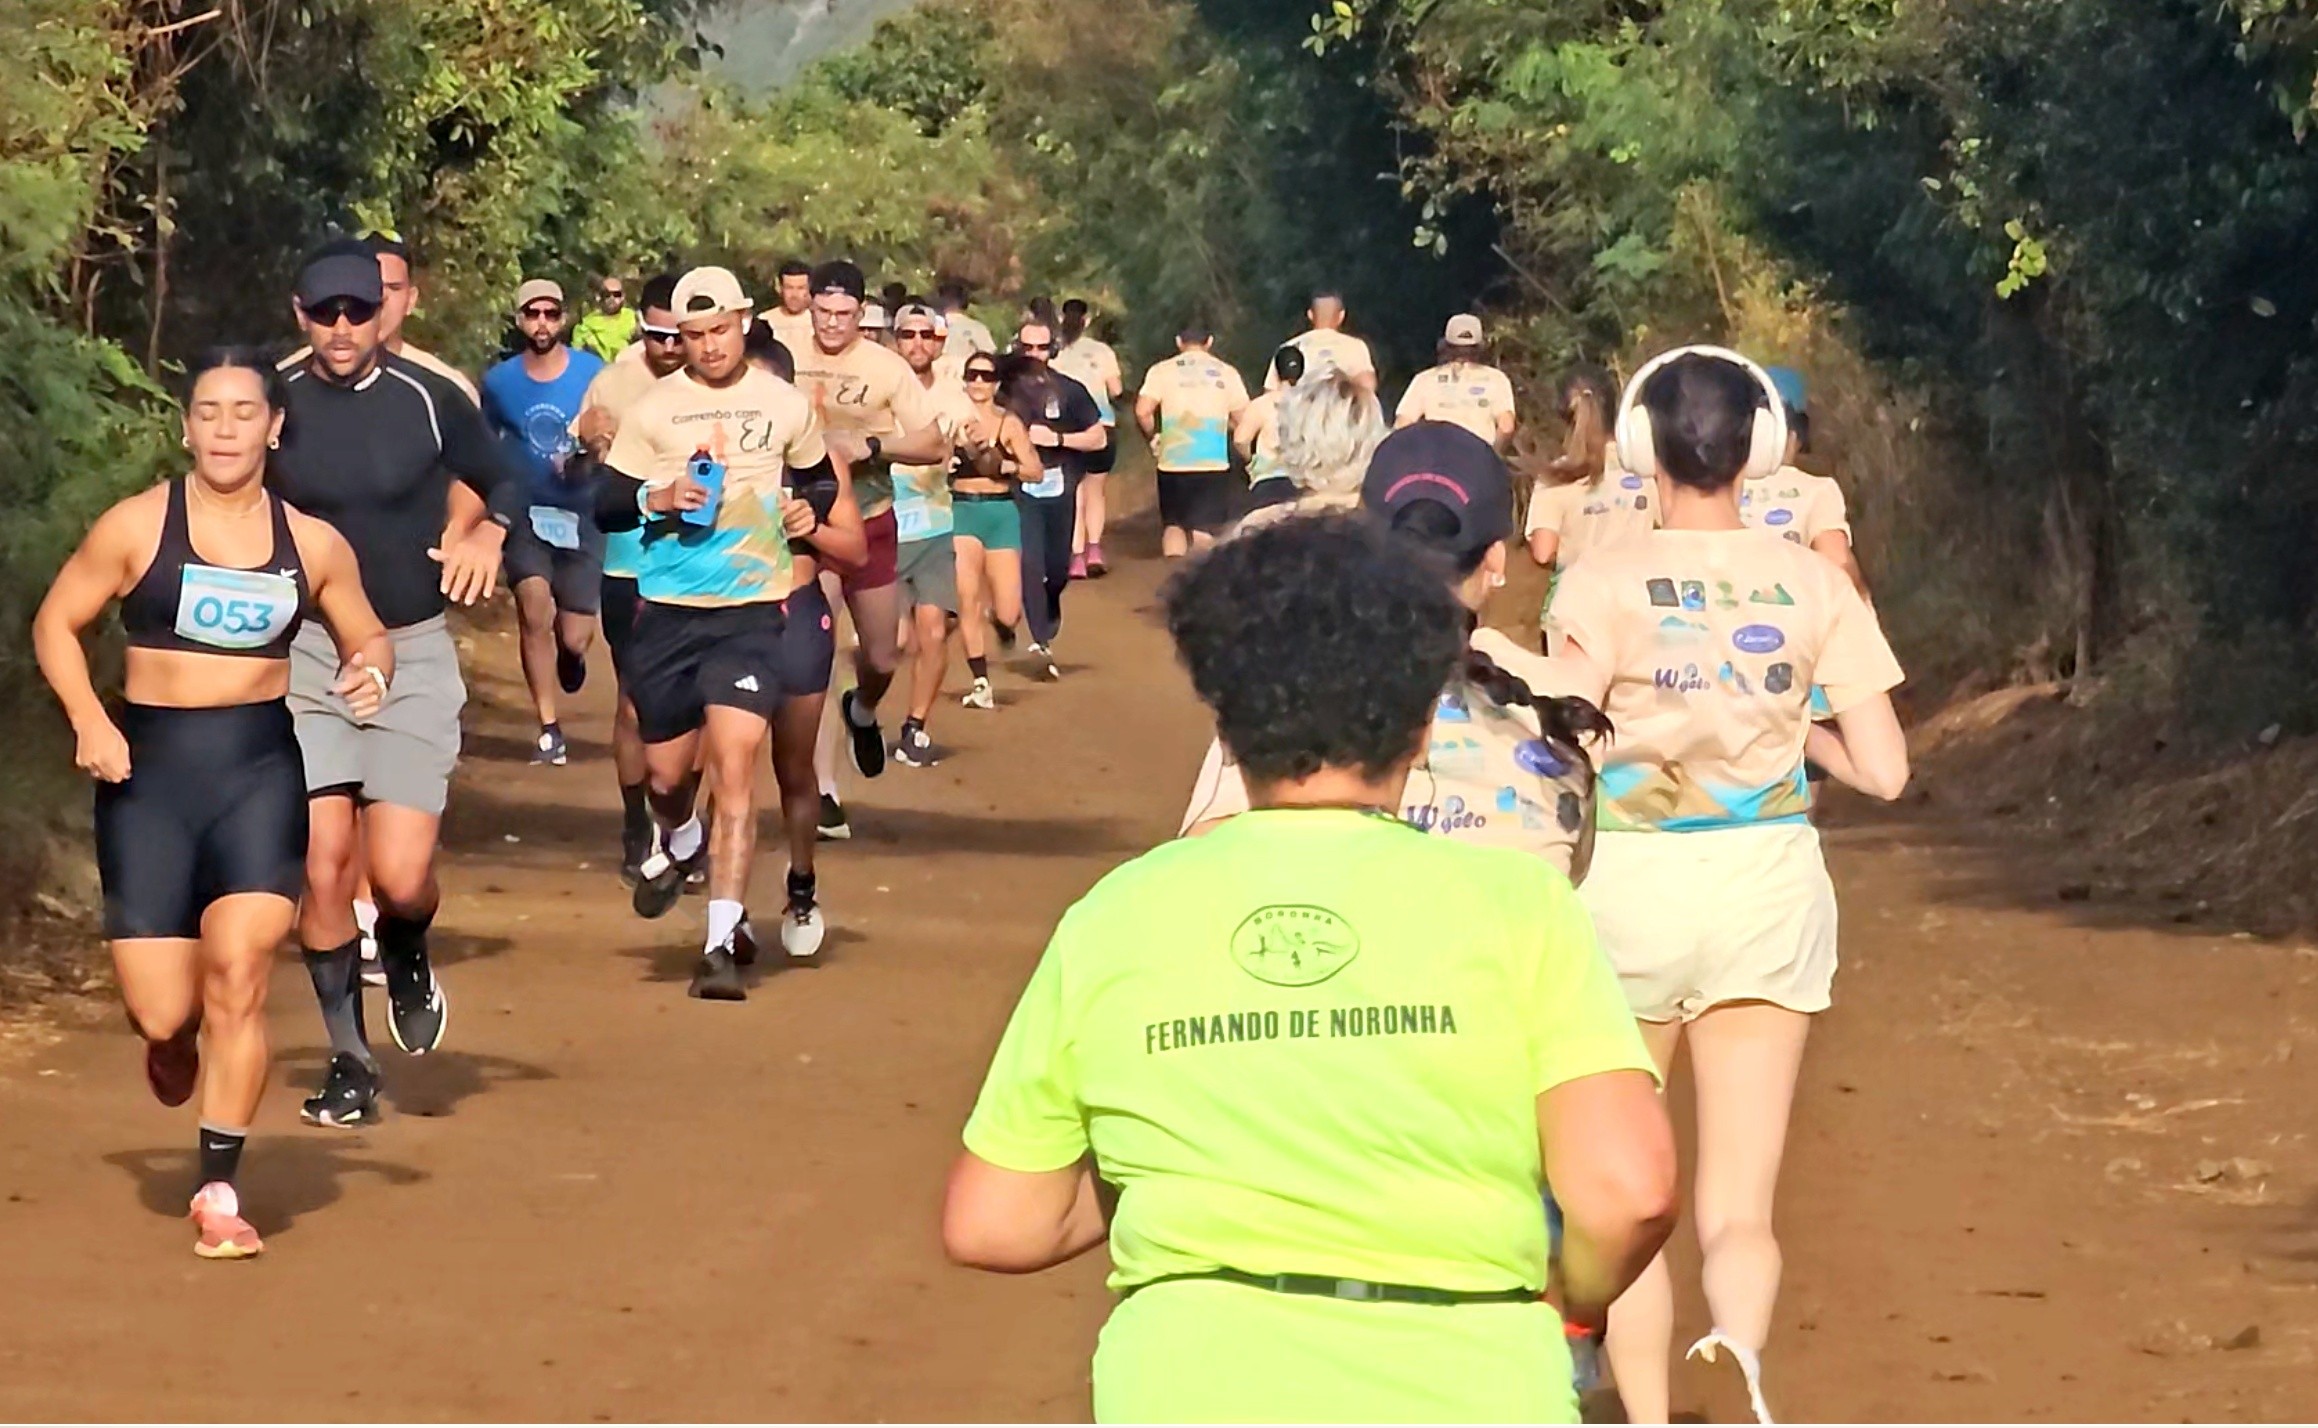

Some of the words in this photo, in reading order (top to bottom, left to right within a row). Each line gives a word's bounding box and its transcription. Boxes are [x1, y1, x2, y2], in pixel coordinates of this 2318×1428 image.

[740, 419, 772, 452] Ed
[193, 596, 274, 635] 053
[1146, 1011, 1279, 1055] FERNANDO
[1289, 1010, 1320, 1038] DE
[1330, 1005, 1457, 1038] NORONHA
